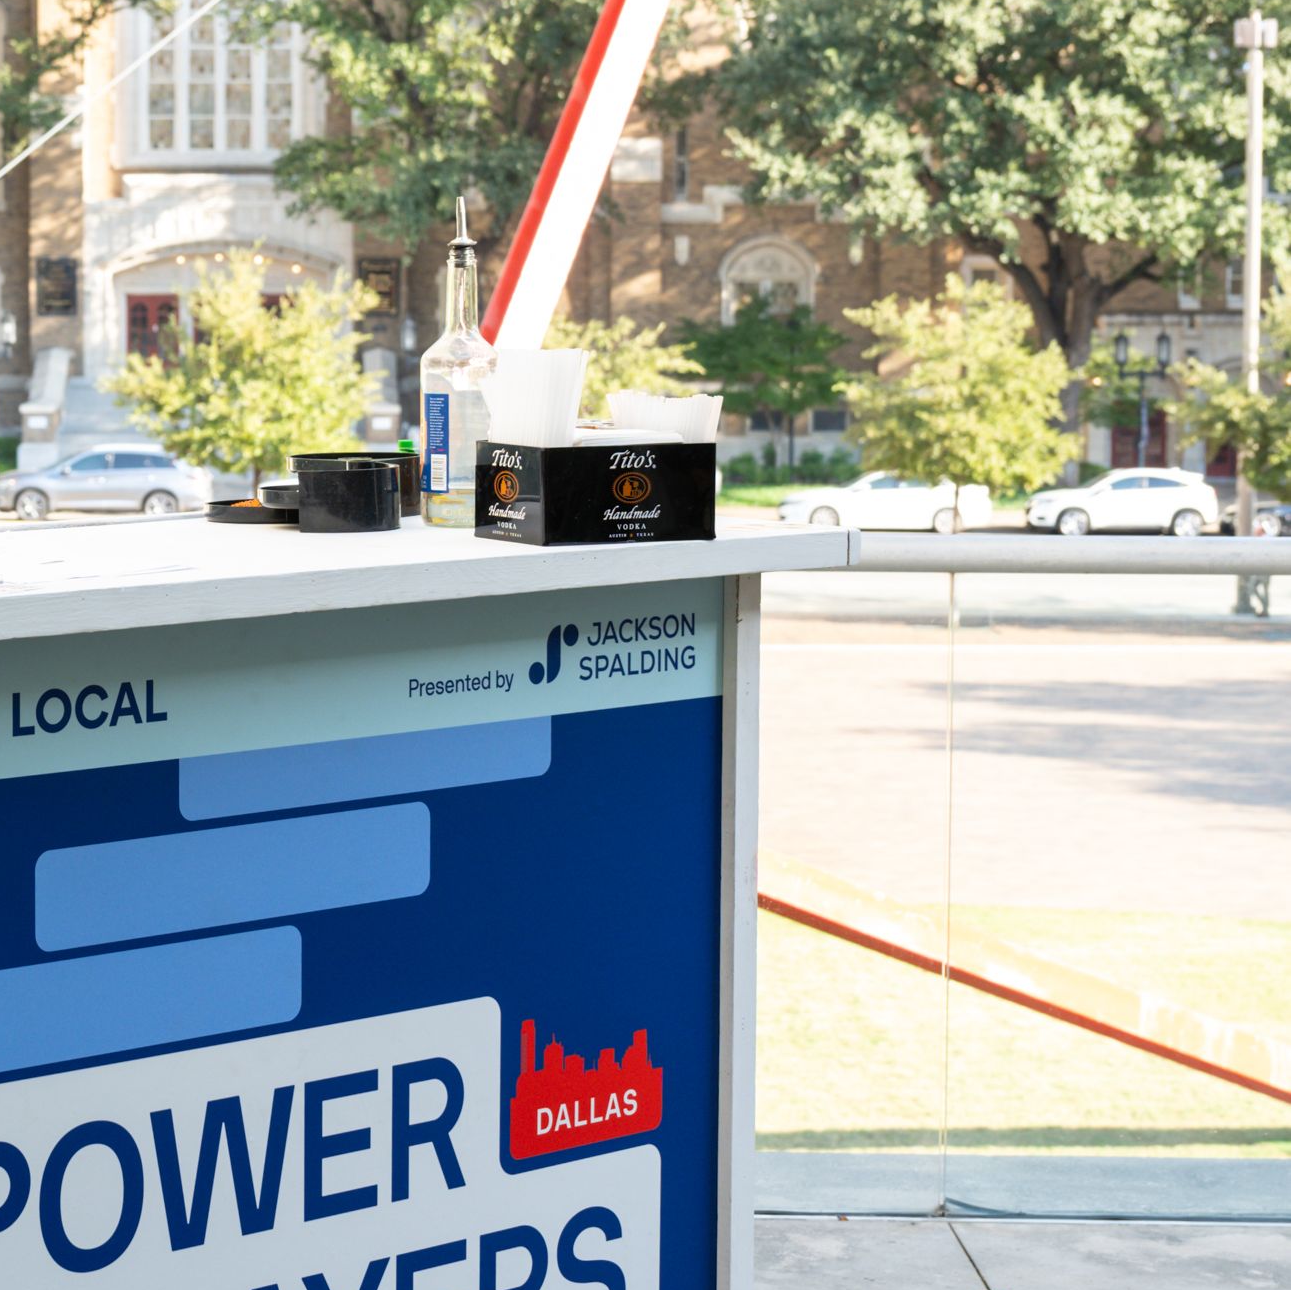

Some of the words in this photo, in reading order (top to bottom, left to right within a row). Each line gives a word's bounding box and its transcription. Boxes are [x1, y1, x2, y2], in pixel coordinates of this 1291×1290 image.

[488, 502, 526, 520] Handmade
[496, 521, 517, 530] VODKA
[603, 504, 661, 521] Handmade
[587, 613, 696, 647] JACKSON
[579, 646, 696, 681] SPALDING
[408, 670, 491, 698] Presented
[494, 669, 514, 694] by
[11, 679, 168, 737] LOCAL
[535, 1088, 638, 1137] DALLAS
